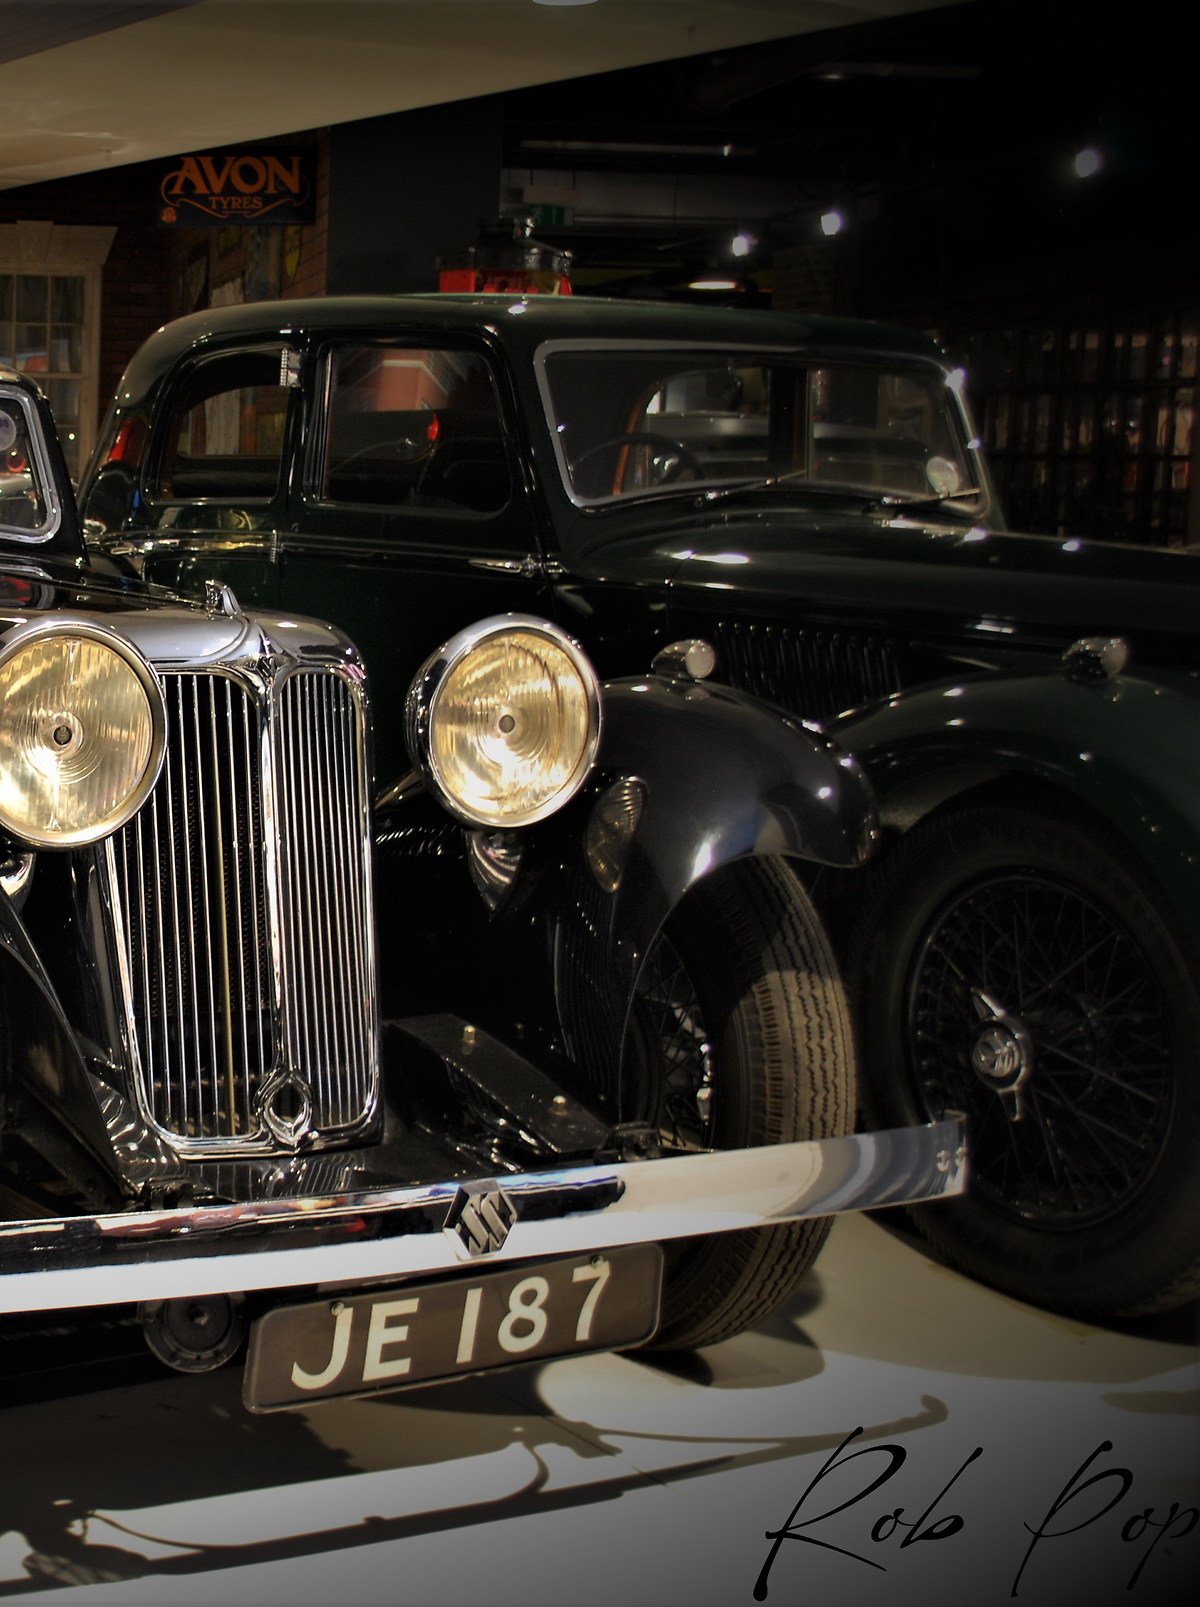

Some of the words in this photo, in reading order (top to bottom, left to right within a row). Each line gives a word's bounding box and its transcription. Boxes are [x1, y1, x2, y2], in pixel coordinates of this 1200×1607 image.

[162, 156, 302, 195] AVON
[208, 196, 263, 209] TYRES
[290, 1297, 420, 1390] JE
[455, 1260, 611, 1364] 187
